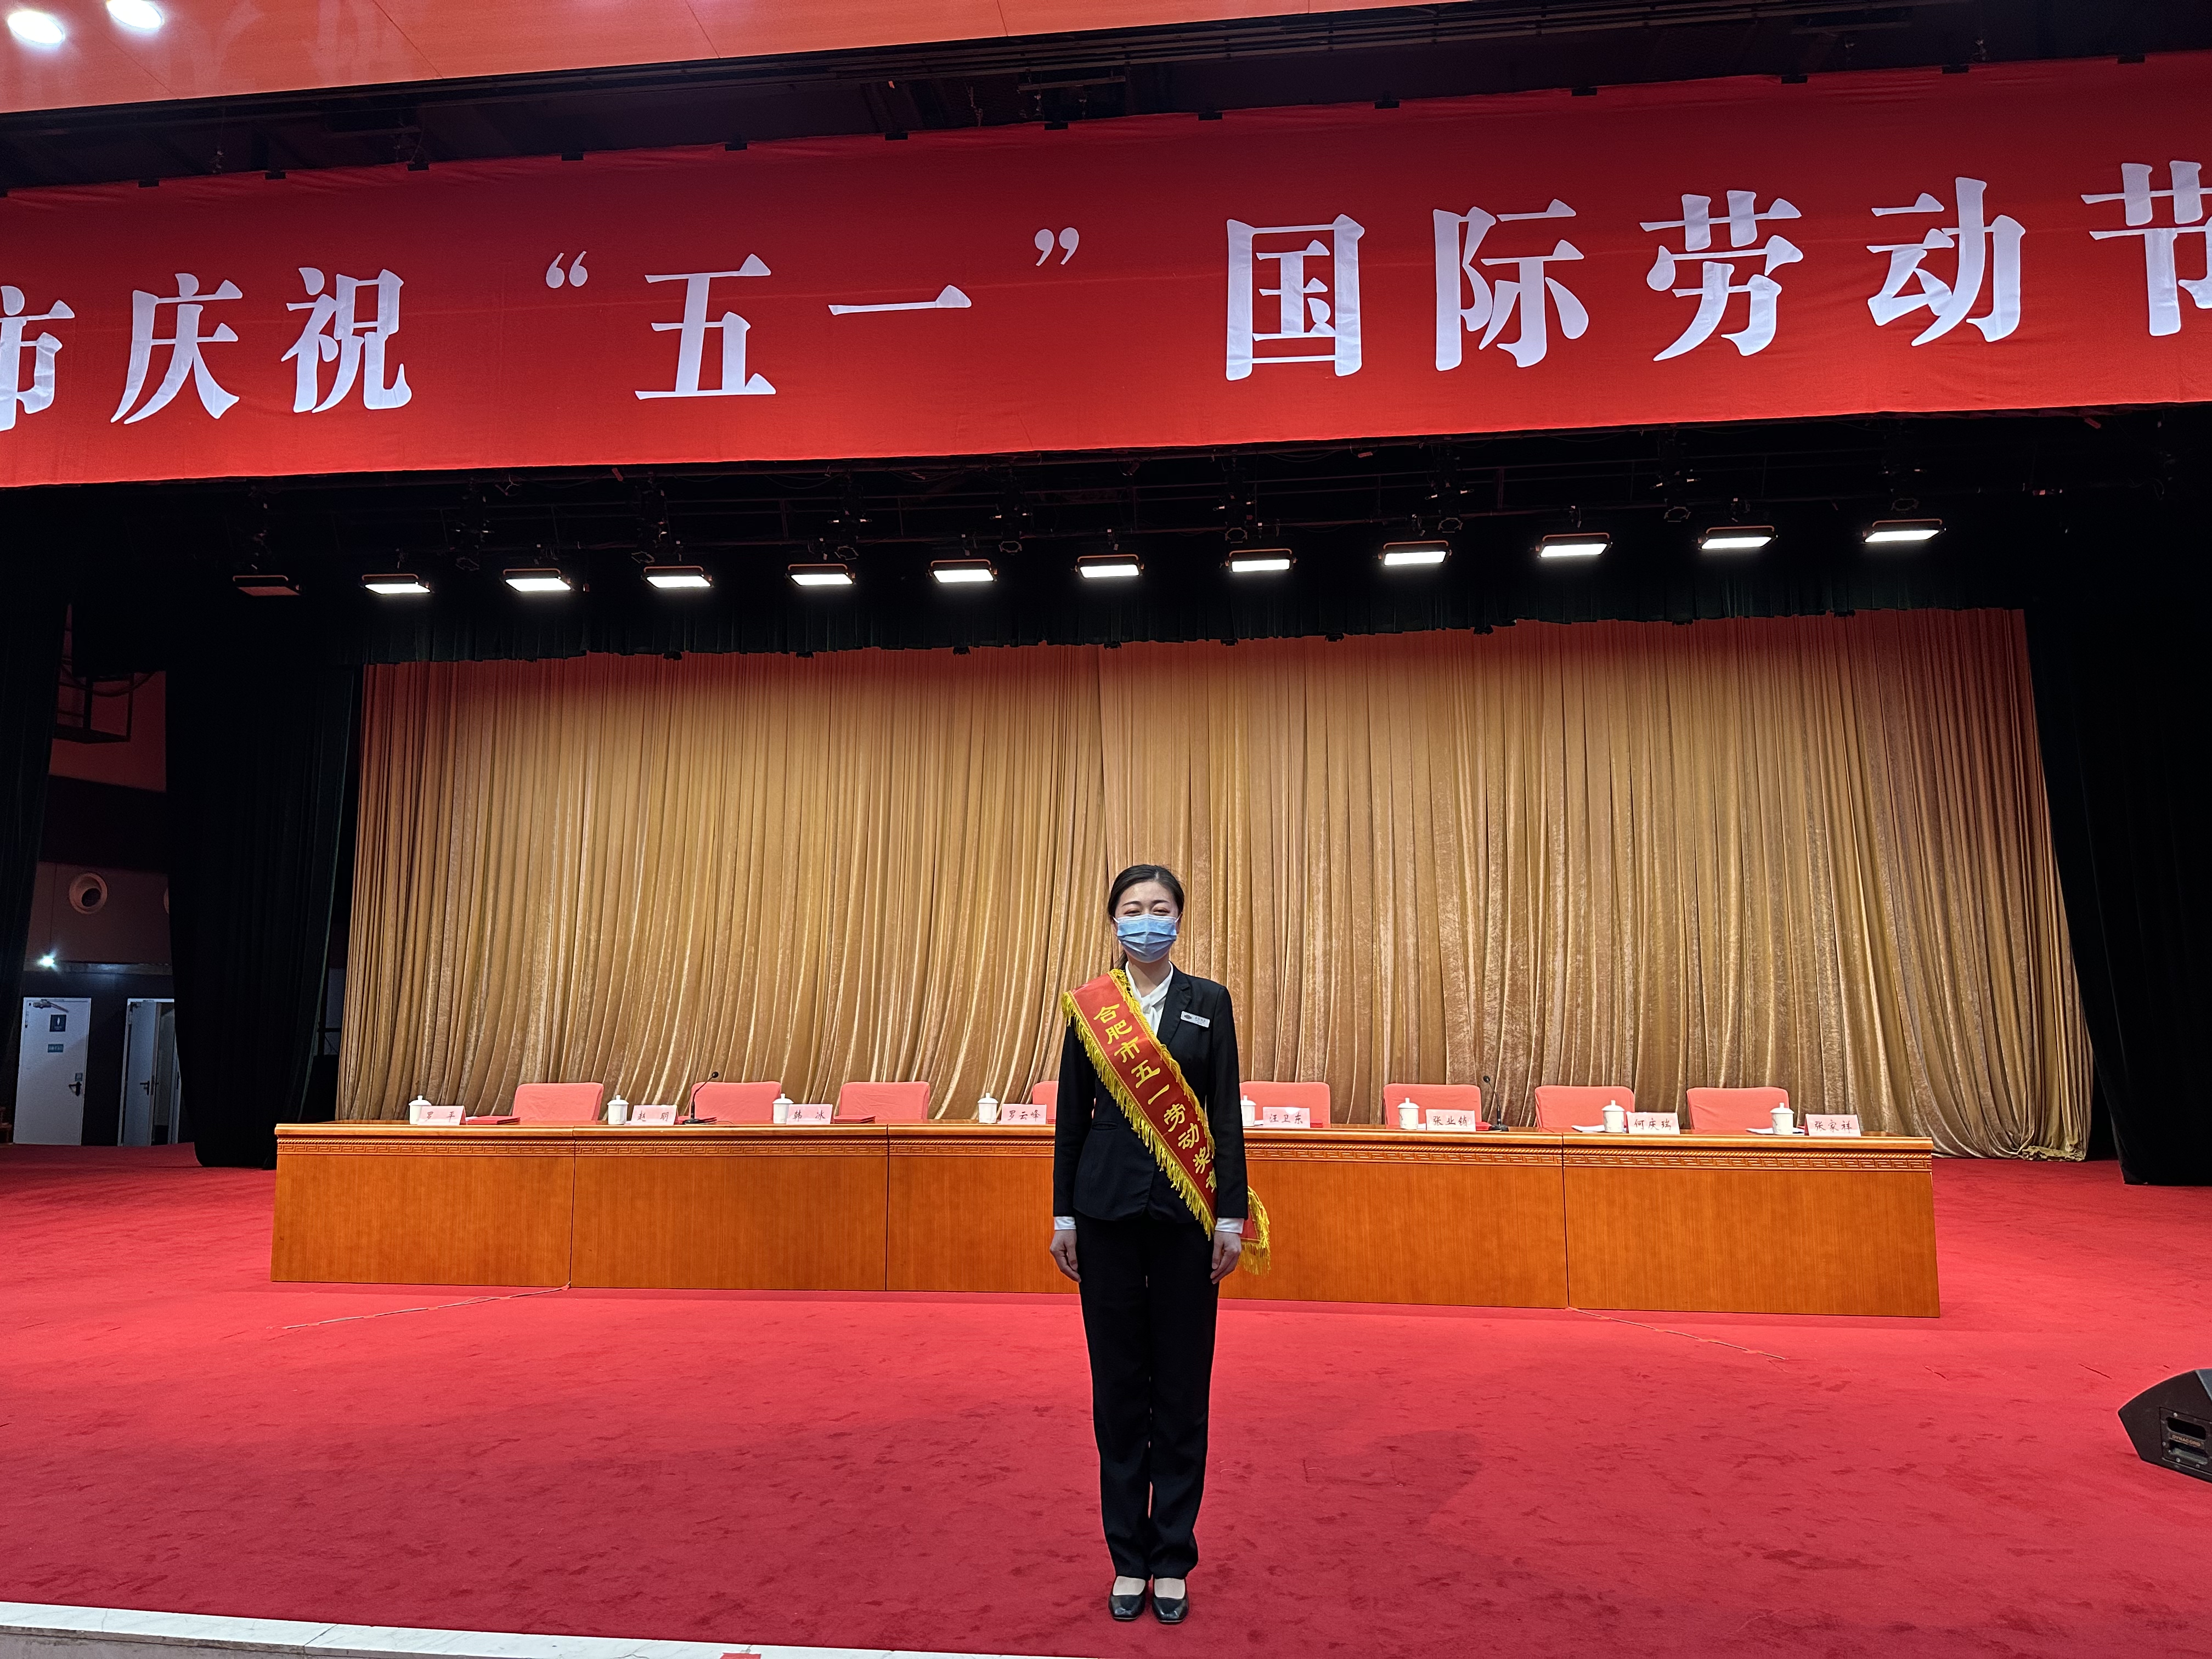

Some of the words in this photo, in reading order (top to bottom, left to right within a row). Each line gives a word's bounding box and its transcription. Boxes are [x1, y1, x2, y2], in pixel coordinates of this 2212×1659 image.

[793, 1109, 826, 1121] 韩冰
[1007, 1109, 1041, 1121] 罗云峰
[1269, 1112, 1303, 1124] 汪卫东
[1814, 1119, 1852, 1133] 张家祥
